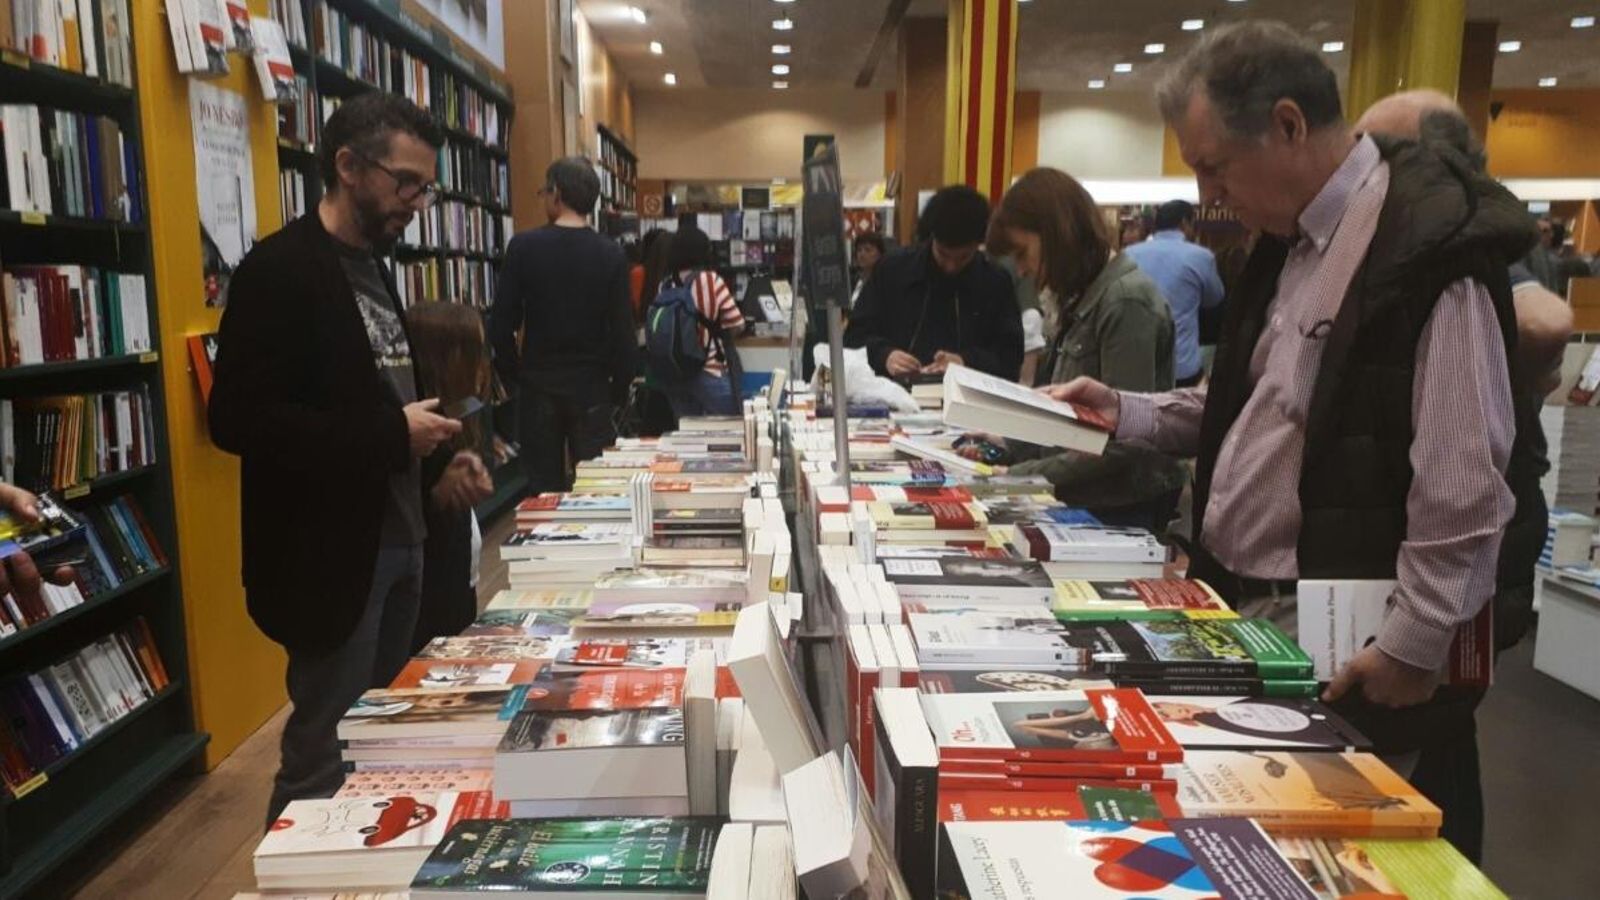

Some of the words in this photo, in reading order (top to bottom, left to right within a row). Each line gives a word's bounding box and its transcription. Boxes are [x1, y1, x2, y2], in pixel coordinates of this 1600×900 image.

[517, 842, 553, 868] baile
[531, 830, 553, 842] El
[602, 817, 642, 886] HANNAH
[638, 815, 673, 887] KRISTIN
